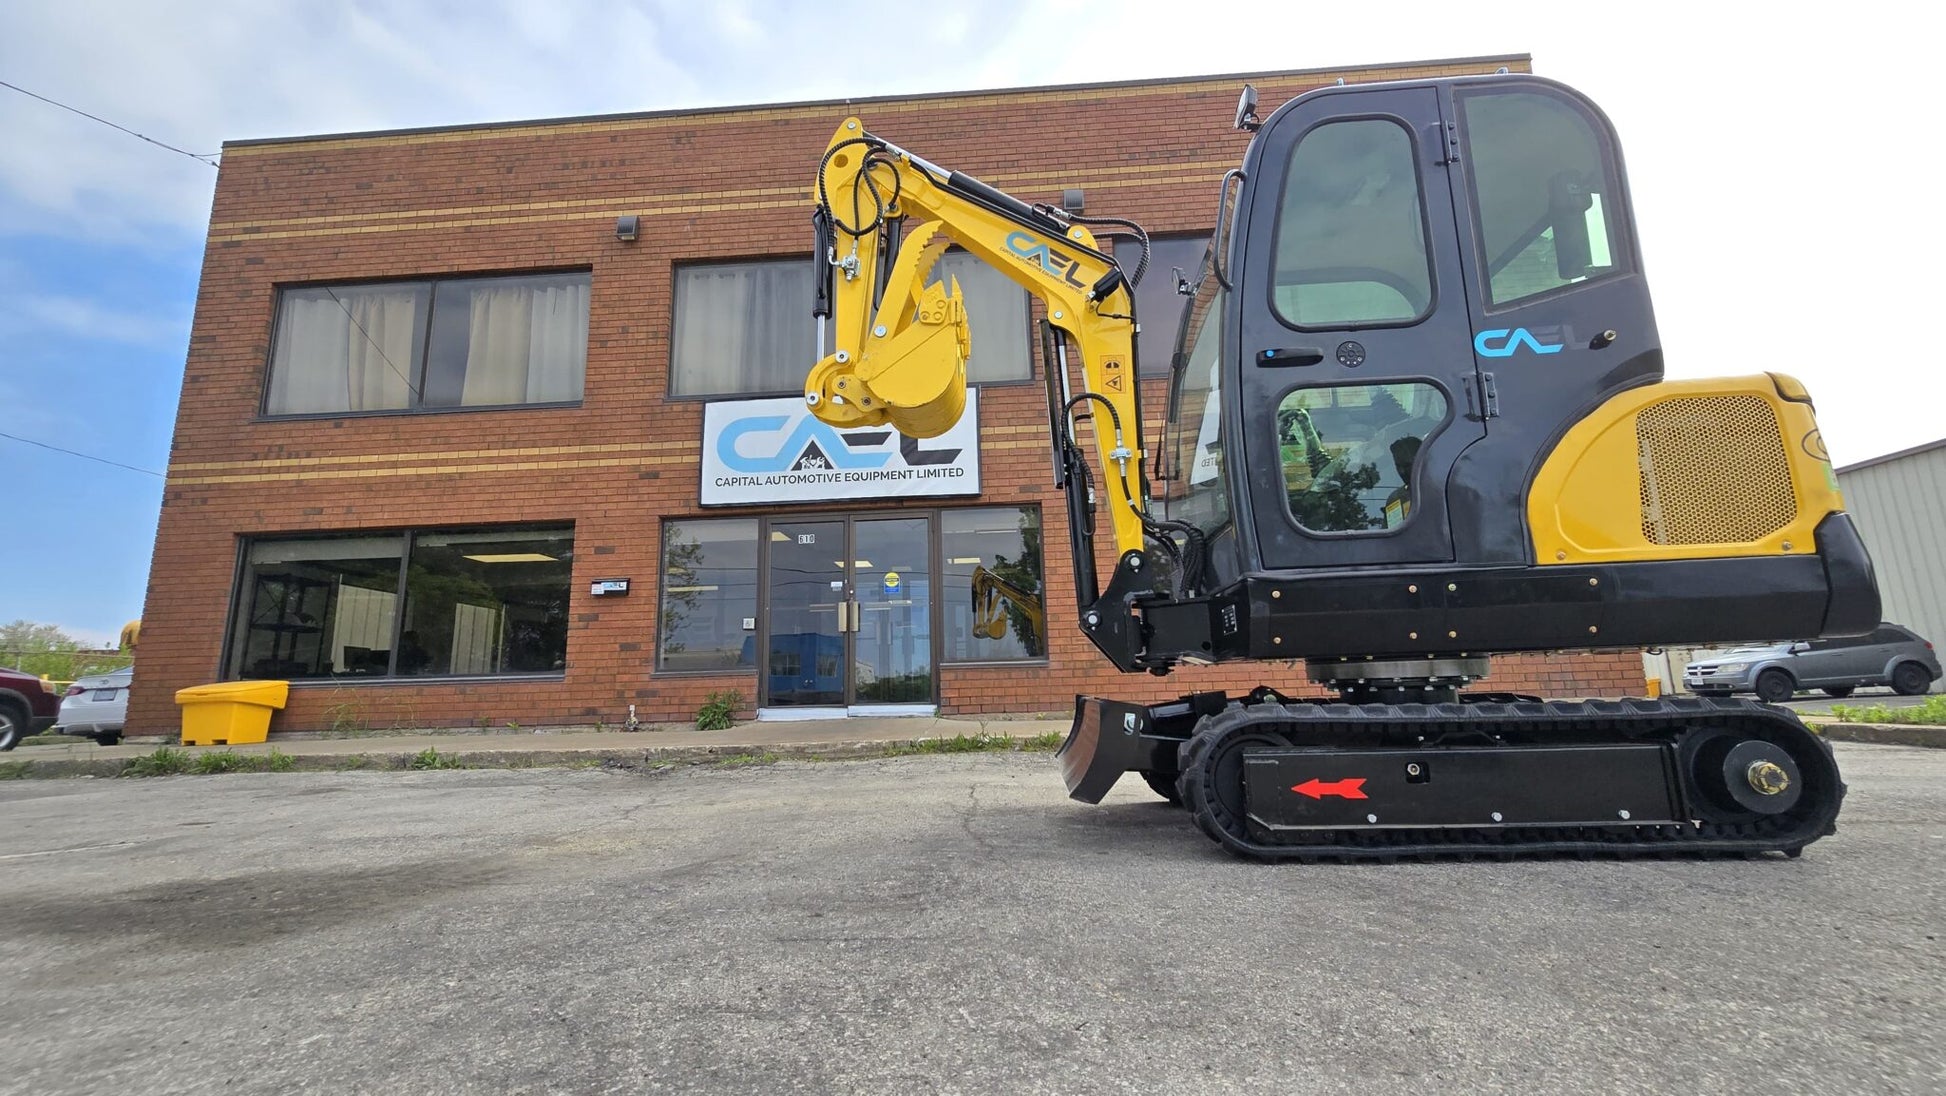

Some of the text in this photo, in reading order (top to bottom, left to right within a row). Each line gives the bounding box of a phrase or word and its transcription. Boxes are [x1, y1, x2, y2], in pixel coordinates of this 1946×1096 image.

[715, 467, 964, 487] CAPITAL AUTOMOTIVE EQUIPMENT LIMITED
